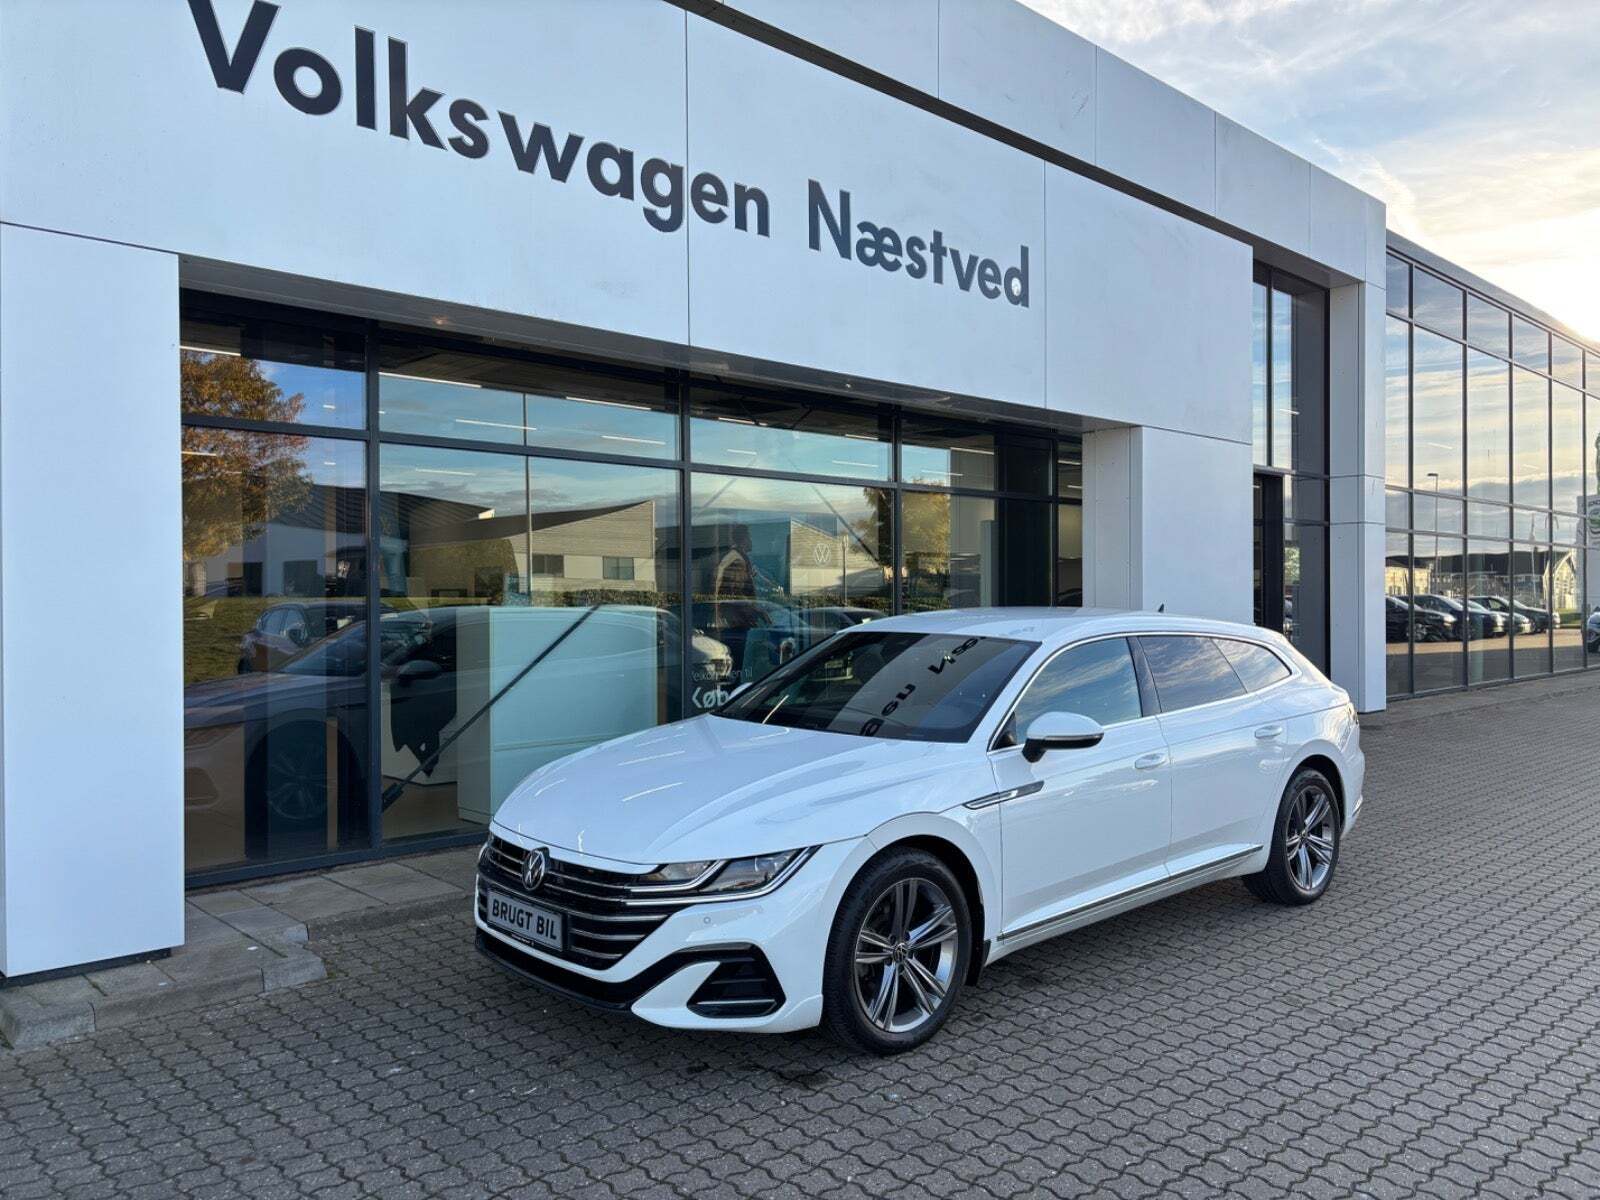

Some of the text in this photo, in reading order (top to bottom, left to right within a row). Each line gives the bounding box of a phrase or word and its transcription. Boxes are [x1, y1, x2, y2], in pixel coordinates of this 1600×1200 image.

[188, 0, 1030, 309] Volkswagen Næstved
[491, 898, 533, 931] BRUGT
[536, 915, 557, 940] BIL
